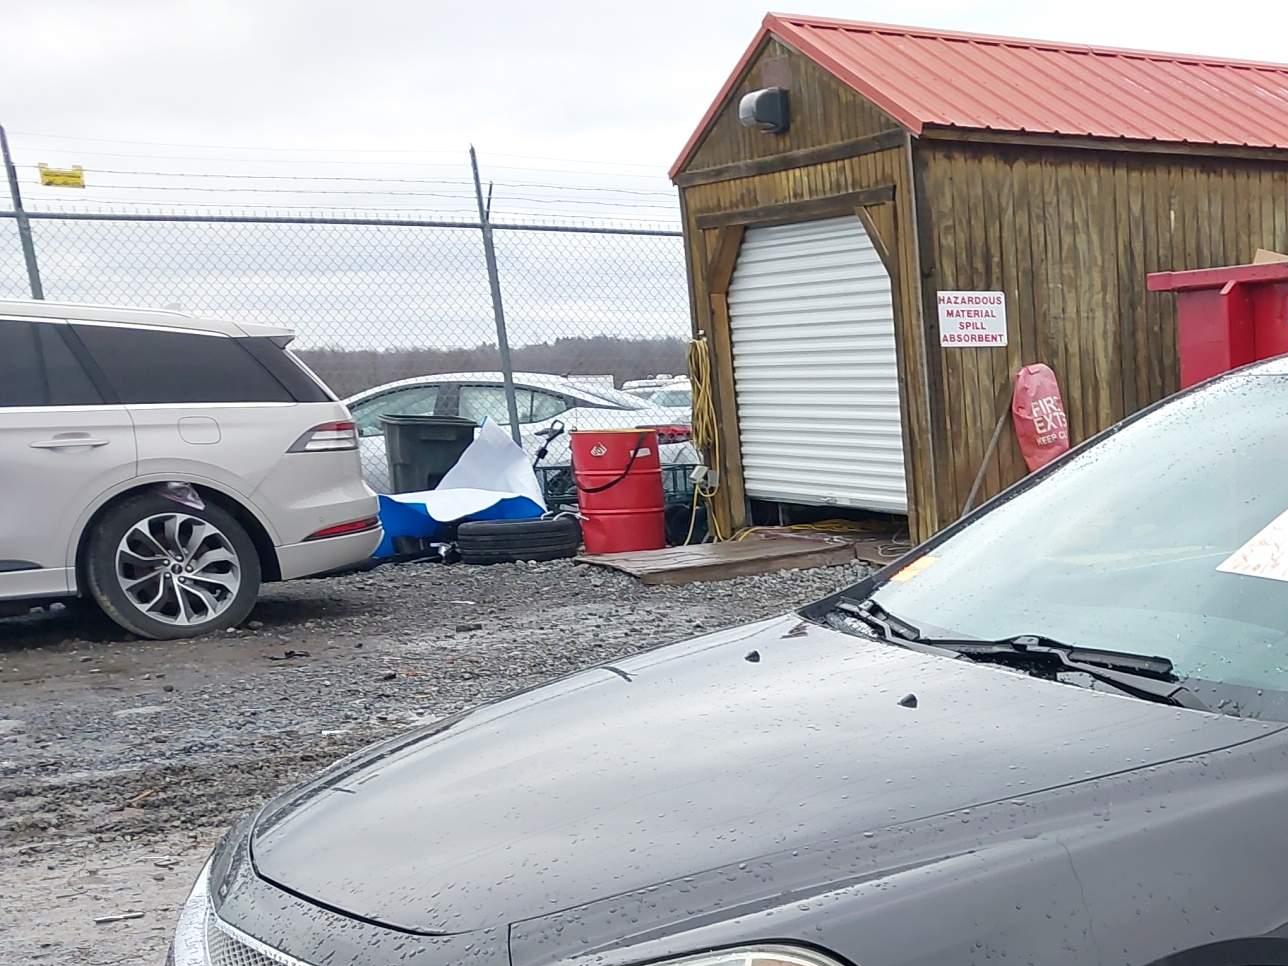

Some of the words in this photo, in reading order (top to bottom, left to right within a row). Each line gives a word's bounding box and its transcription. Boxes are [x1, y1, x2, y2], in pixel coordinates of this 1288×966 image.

[938, 296, 1002, 305] HAZARDOUS
[946, 309, 996, 318] MATERIAL
[959, 321, 986, 330] SPILL
[942, 333, 1004, 343] ABSORBENT
